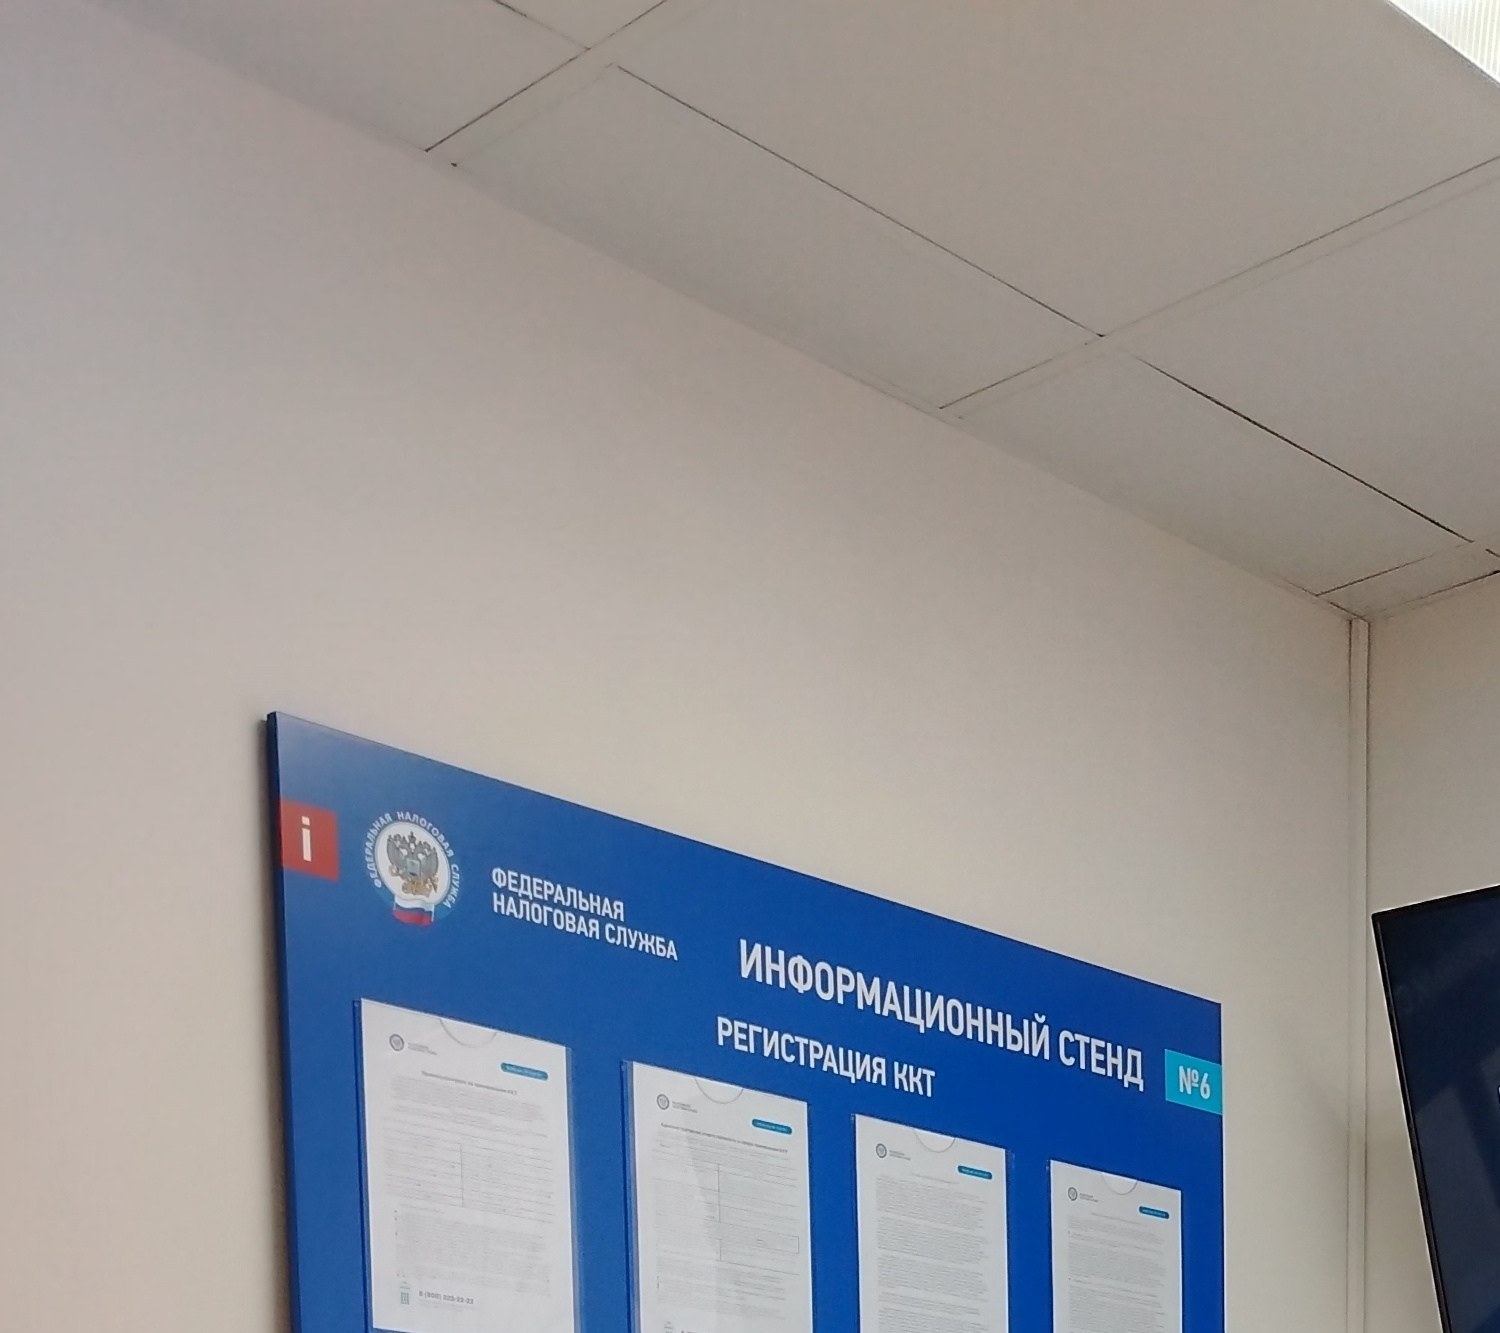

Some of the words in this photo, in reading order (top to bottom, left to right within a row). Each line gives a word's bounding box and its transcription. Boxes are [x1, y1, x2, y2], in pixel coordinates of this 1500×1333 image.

[363, 812, 394, 889] ФЕДЕРАЛЬНАЯ
[396, 811, 455, 858] НАЛОГОВАЯ
[442, 863, 461, 909] СЛУЖБА
[492, 867, 625, 922] ФЕДЕРАЛЬНАЯ
[492, 892, 601, 941] НАЛОГОВАЯ
[604, 922, 678, 961] СЛУЖБА
[739, 938, 1051, 1061] ИНФОРМАЦИОННЫЙ
[1058, 1029, 1145, 1092] СТЕНД
[716, 1016, 887, 1087] РЕГИСТРАЦИЯ
[894, 1061, 936, 1098] ККТ
[1178, 1065, 1212, 1101] №6
